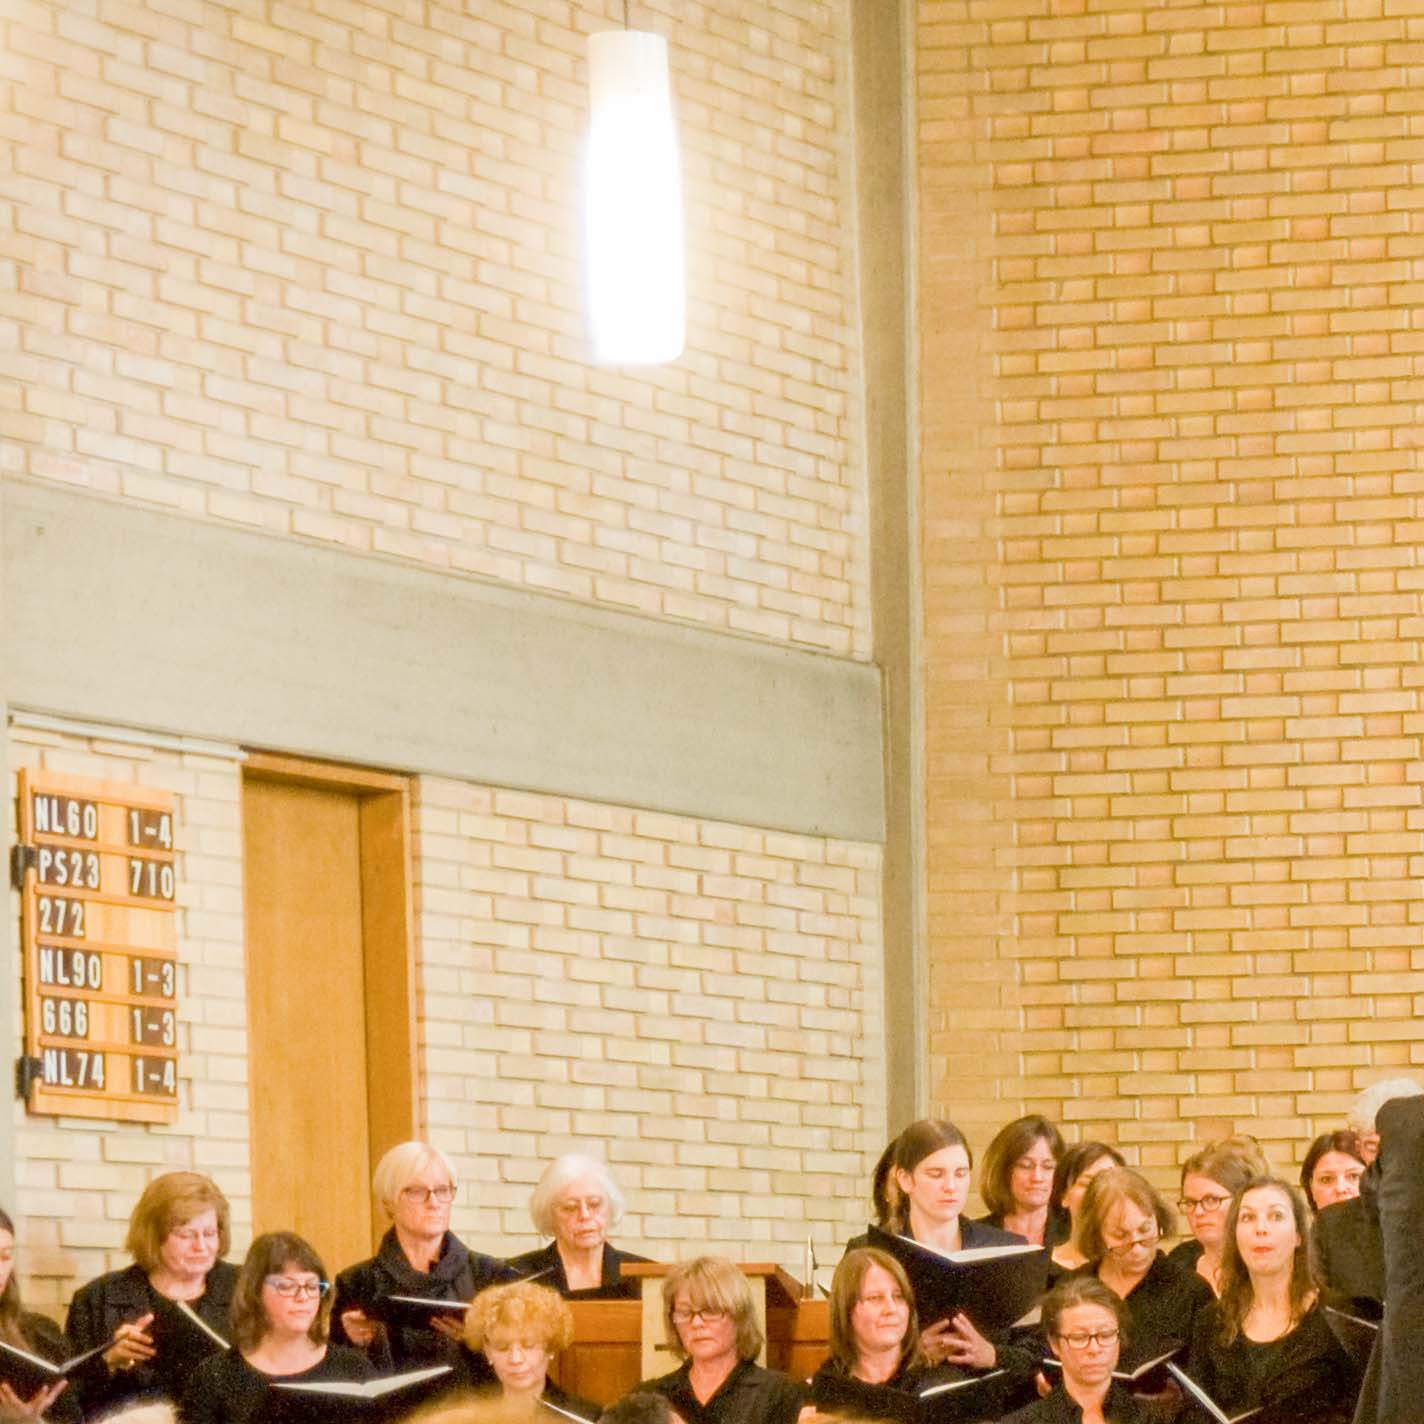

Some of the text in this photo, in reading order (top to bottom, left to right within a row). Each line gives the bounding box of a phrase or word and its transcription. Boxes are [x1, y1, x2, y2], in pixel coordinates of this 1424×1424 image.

[130, 810, 172, 849] 1-4
[131, 860, 173, 899] 710
[39, 896, 85, 937] 272
[133, 959, 174, 997] 1-3
[43, 999, 174, 1045] 666 1-3
[135, 1058, 176, 1093] 1-4
